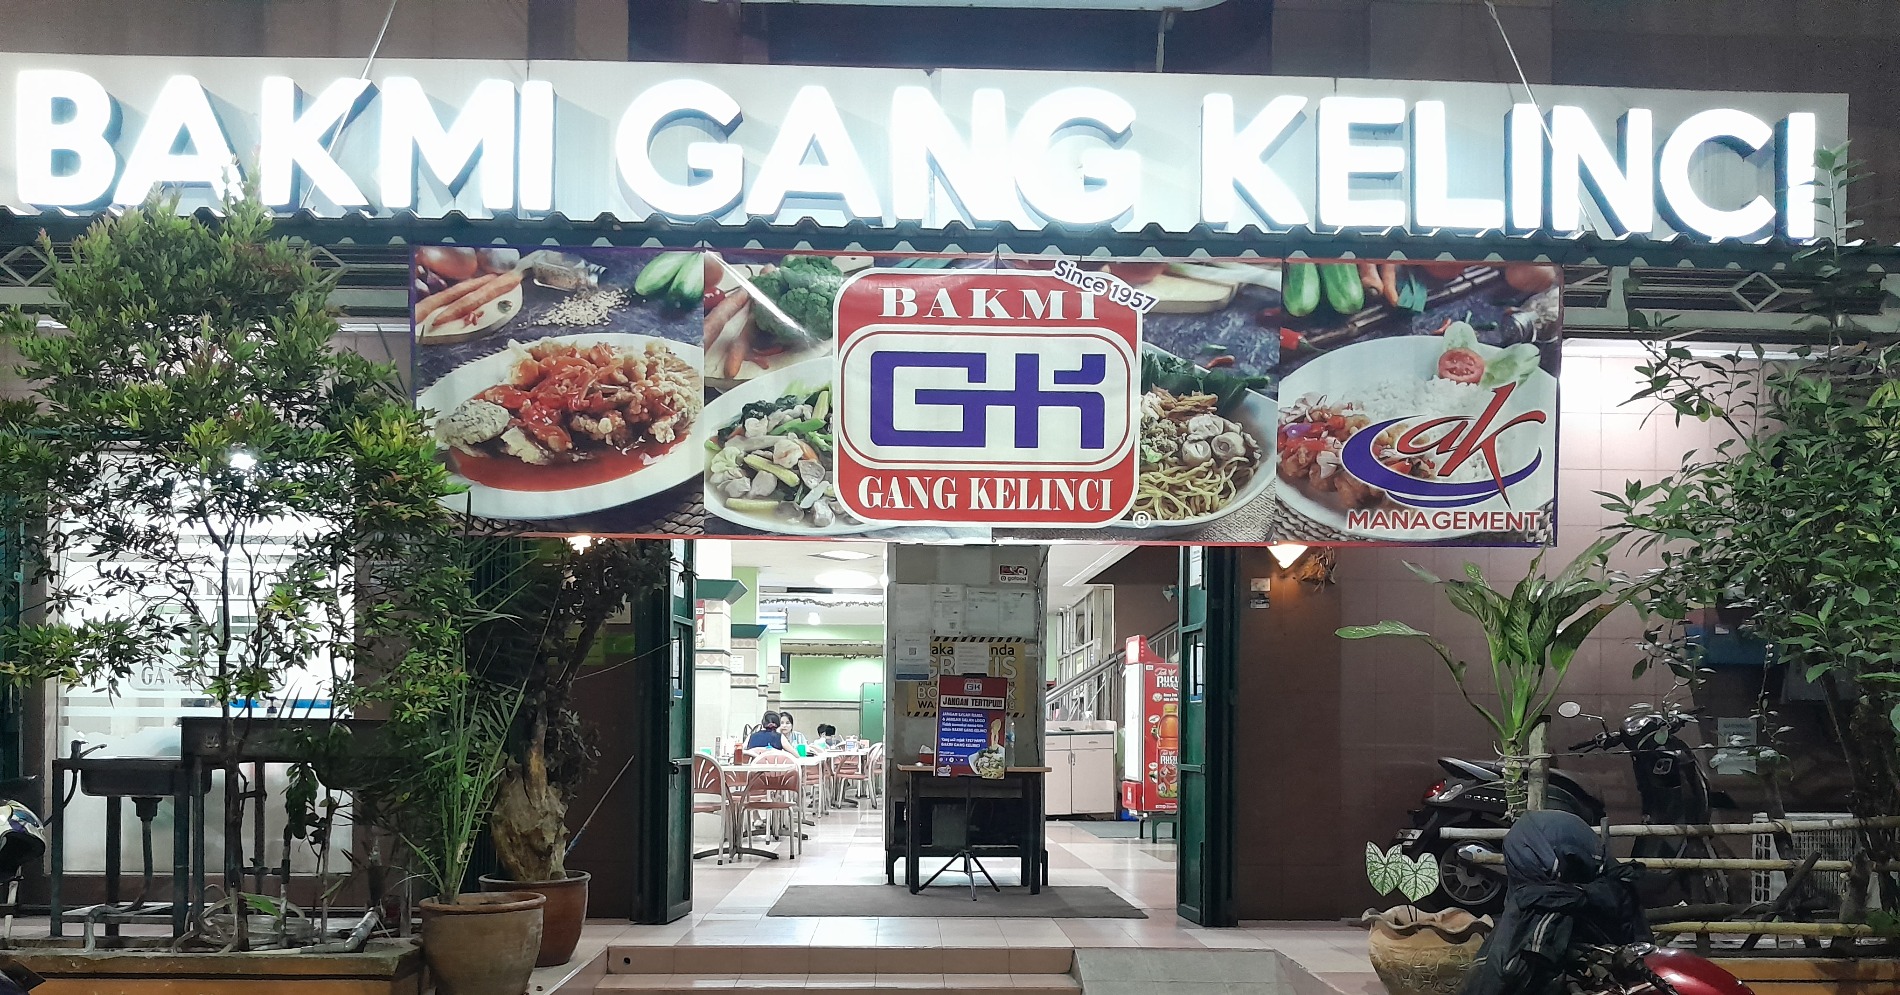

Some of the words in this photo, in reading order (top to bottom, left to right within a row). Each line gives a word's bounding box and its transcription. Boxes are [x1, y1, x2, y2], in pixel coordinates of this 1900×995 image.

[16, 69, 555, 212] BAKMI
[615, 79, 1142, 226] GANG
[1200, 93, 1818, 241] KELINCI
[878, 286, 1100, 320] BAKMI
[1054, 260, 1105, 293] Since
[1111, 284, 1157, 311] 1957
[870, 350, 1107, 450] GK
[857, 475, 958, 510] GANG
[968, 477, 1114, 511] KELINCI
[1348, 510, 1541, 531] MANAGEMENT
[931, 643, 954, 655] aka
[990, 643, 1015, 655] nda
[942, 696, 969, 706] JANGAN
